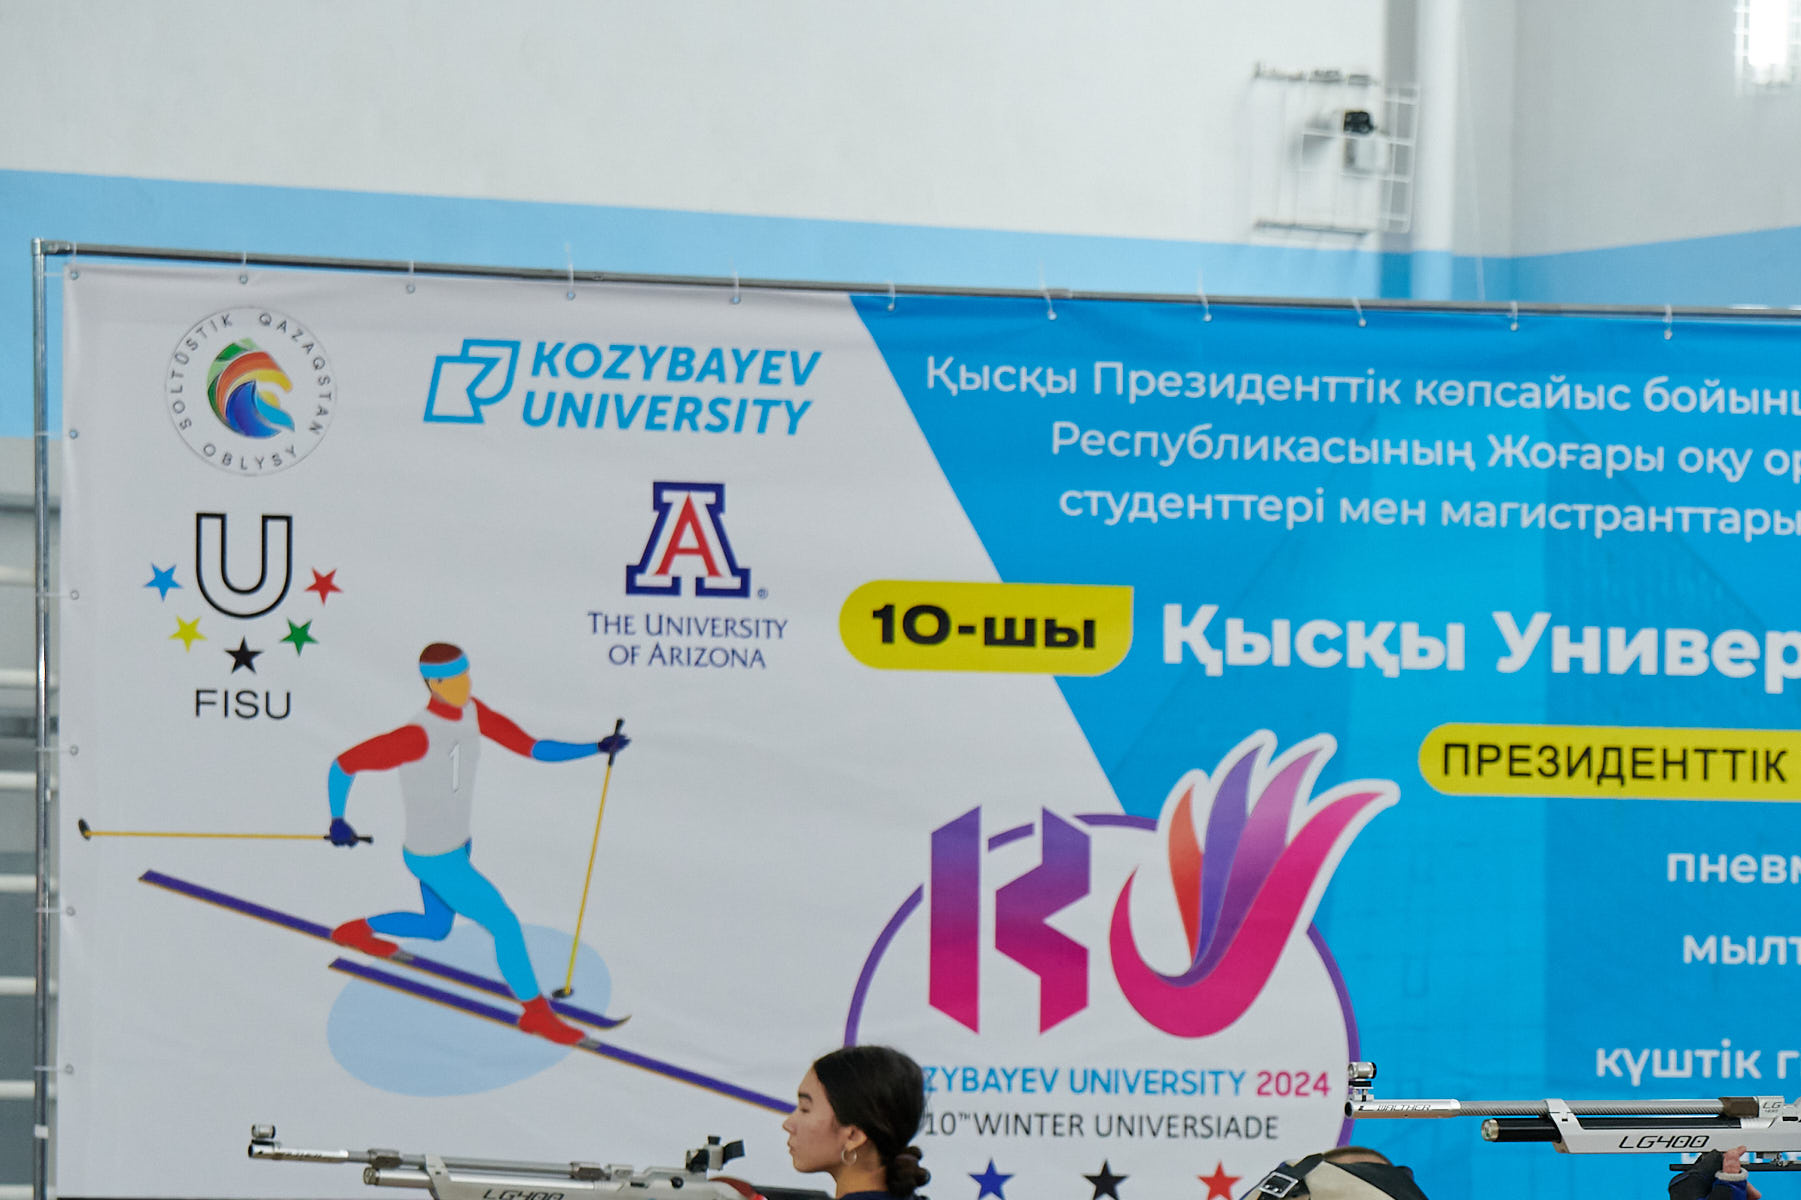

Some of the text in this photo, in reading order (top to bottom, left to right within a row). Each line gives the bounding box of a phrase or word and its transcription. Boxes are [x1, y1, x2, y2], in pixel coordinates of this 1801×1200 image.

[259, 312, 332, 435] QAZAQSTAN
[530, 340, 823, 387] KOZYBAYEV
[928, 356, 1077, 398] Қысқы
[1094, 361, 1401, 405] Президенттік
[1415, 375, 1631, 412] көпсайыс
[521, 390, 814, 436] UNIVERSITY
[203, 444, 297, 470] OBLYSY
[1052, 421, 1476, 471] Республикасының
[1487, 434, 1665, 476] Жоғары
[1678, 446, 1753, 483] оқу
[1059, 487, 1324, 530] студенттері
[1340, 497, 1426, 526] мен
[588, 611, 788, 640] THE UNIVERSITY
[872, 603, 1096, 649] 10-шы
[1163, 603, 1466, 678] Қысқы
[608, 641, 766, 669] OF ARIZONA
[194, 687, 292, 721] FISU
[1443, 742, 1787, 787] ПРЕЗИДЕНТТІК
[922, 1065, 1331, 1097] ZYBAYEV UNIVERSITY 2024
[1596, 1038, 1762, 1087] күштік
[973, 1112, 1085, 1138] WINTER
[1094, 1114, 1280, 1140] UNIVERSIADE
[1618, 1133, 1711, 1150] LG400
